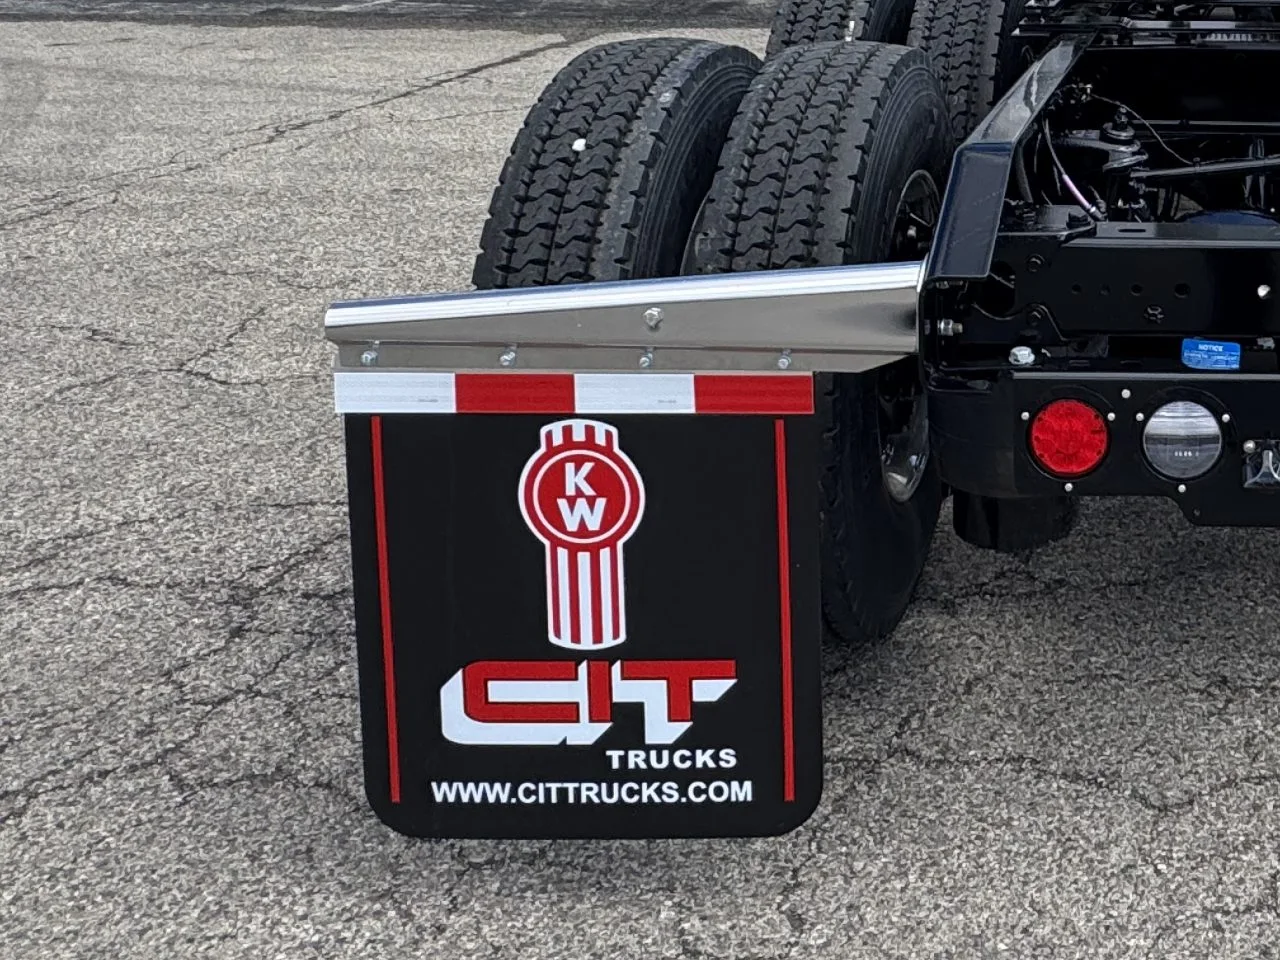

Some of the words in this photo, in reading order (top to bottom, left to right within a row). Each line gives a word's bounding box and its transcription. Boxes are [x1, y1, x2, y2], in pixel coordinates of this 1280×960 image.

[440, 659, 738, 745] CIT
[606, 748, 738, 769] TRUCKS
[431, 780, 753, 804] WWW.CITTRUCKS.COM
